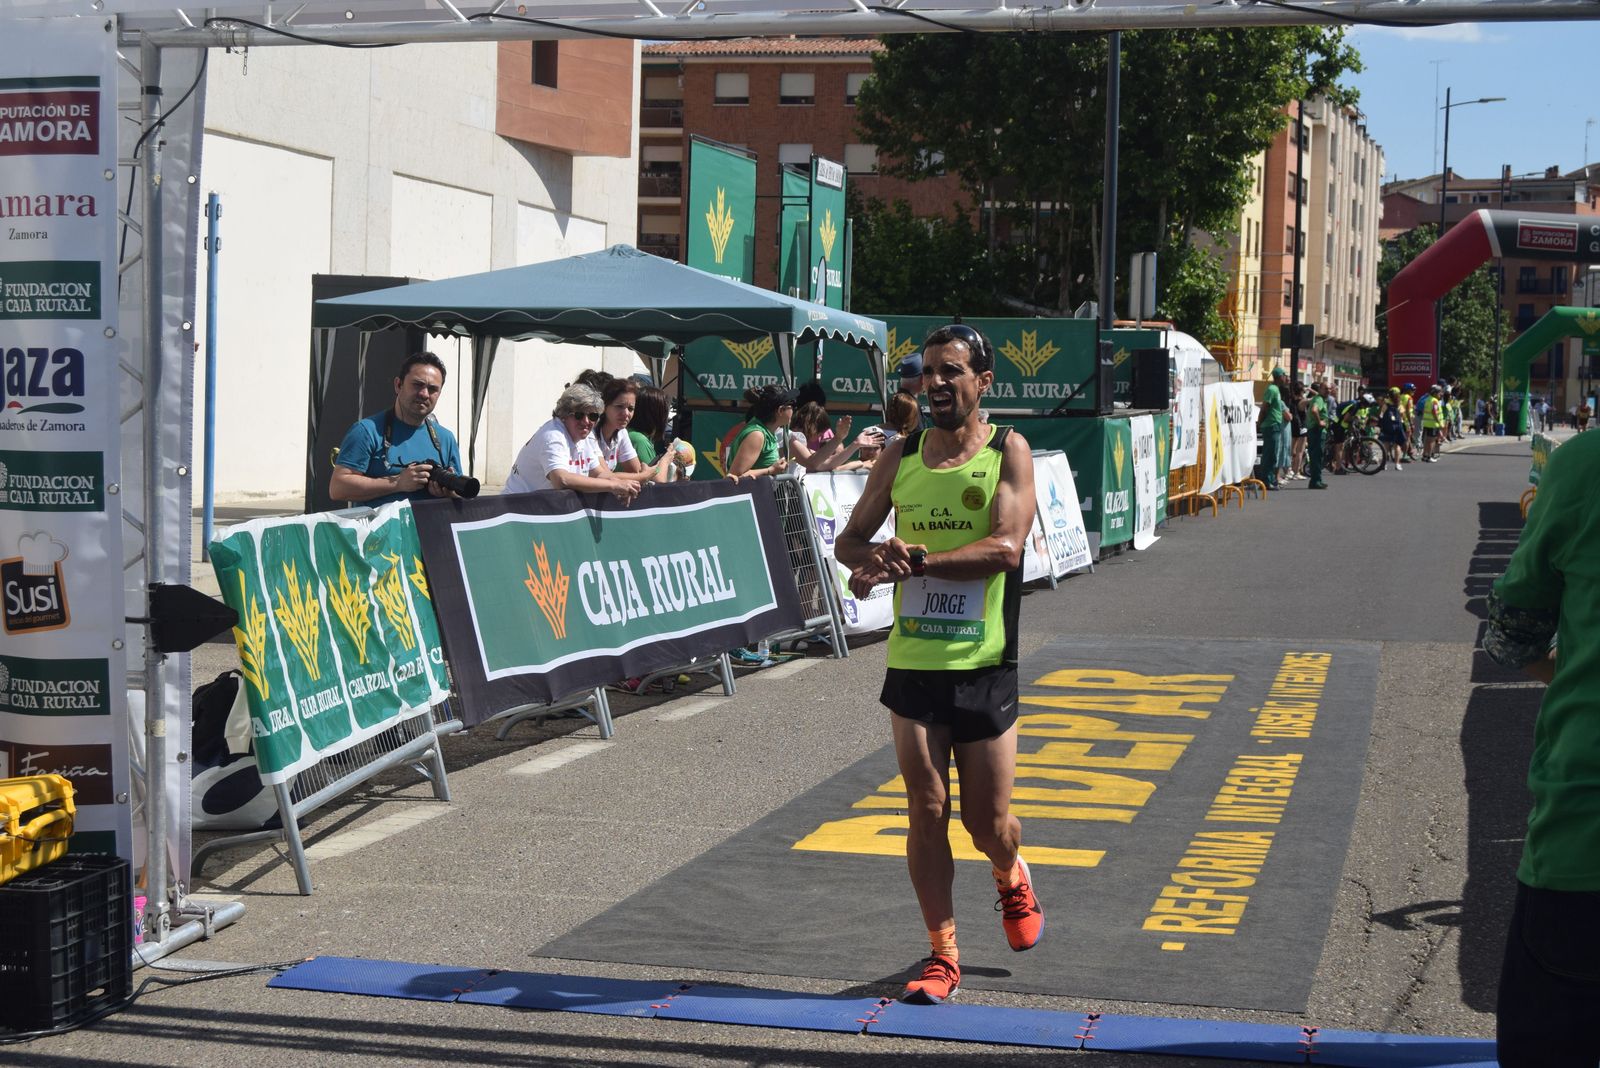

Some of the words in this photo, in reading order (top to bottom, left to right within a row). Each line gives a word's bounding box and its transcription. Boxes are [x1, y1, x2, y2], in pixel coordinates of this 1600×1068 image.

[0, 103, 66, 118] PUTACIÓN
[70, 104, 90, 117] DE
[0, 120, 92, 142] AMORA
[8, 228, 48, 240] Zamora
[1531, 236, 1574, 246] ZAMORA
[5, 283, 91, 297] FUNDACION
[6, 298, 33, 313] CAJA
[36, 299, 91, 312] RURAL
[697, 373, 737, 389] CAJA
[832, 378, 876, 393] CAJA
[982, 383, 1016, 398] AJA
[1022, 383, 1086, 398] RURAL
[27, 420, 37, 431] de
[40, 420, 85, 432] Zamora
[9, 474, 94, 489] FUNDACION
[9, 490, 35, 504] CAJA
[38, 491, 94, 504] RURAL
[931, 508, 952, 517] C.A.
[912, 522, 925, 531] LA
[928, 518, 973, 531] BAÑEZA
[577, 559, 650, 627] CAJA
[641, 545, 736, 615] RURAL
[922, 579, 927, 589] 5
[6, 577, 59, 615] Susi
[922, 592, 966, 615] JORGE
[921, 624, 944, 634] CAJA
[946, 627, 979, 636] RURAL
[11, 678, 100, 694] FUNDACION
[11, 693, 39, 708] CAJA
[43, 694, 100, 708] RURAL
[1204, 752, 1303, 824] INTEGRAL
[1141, 830, 1275, 935] REFORMA
